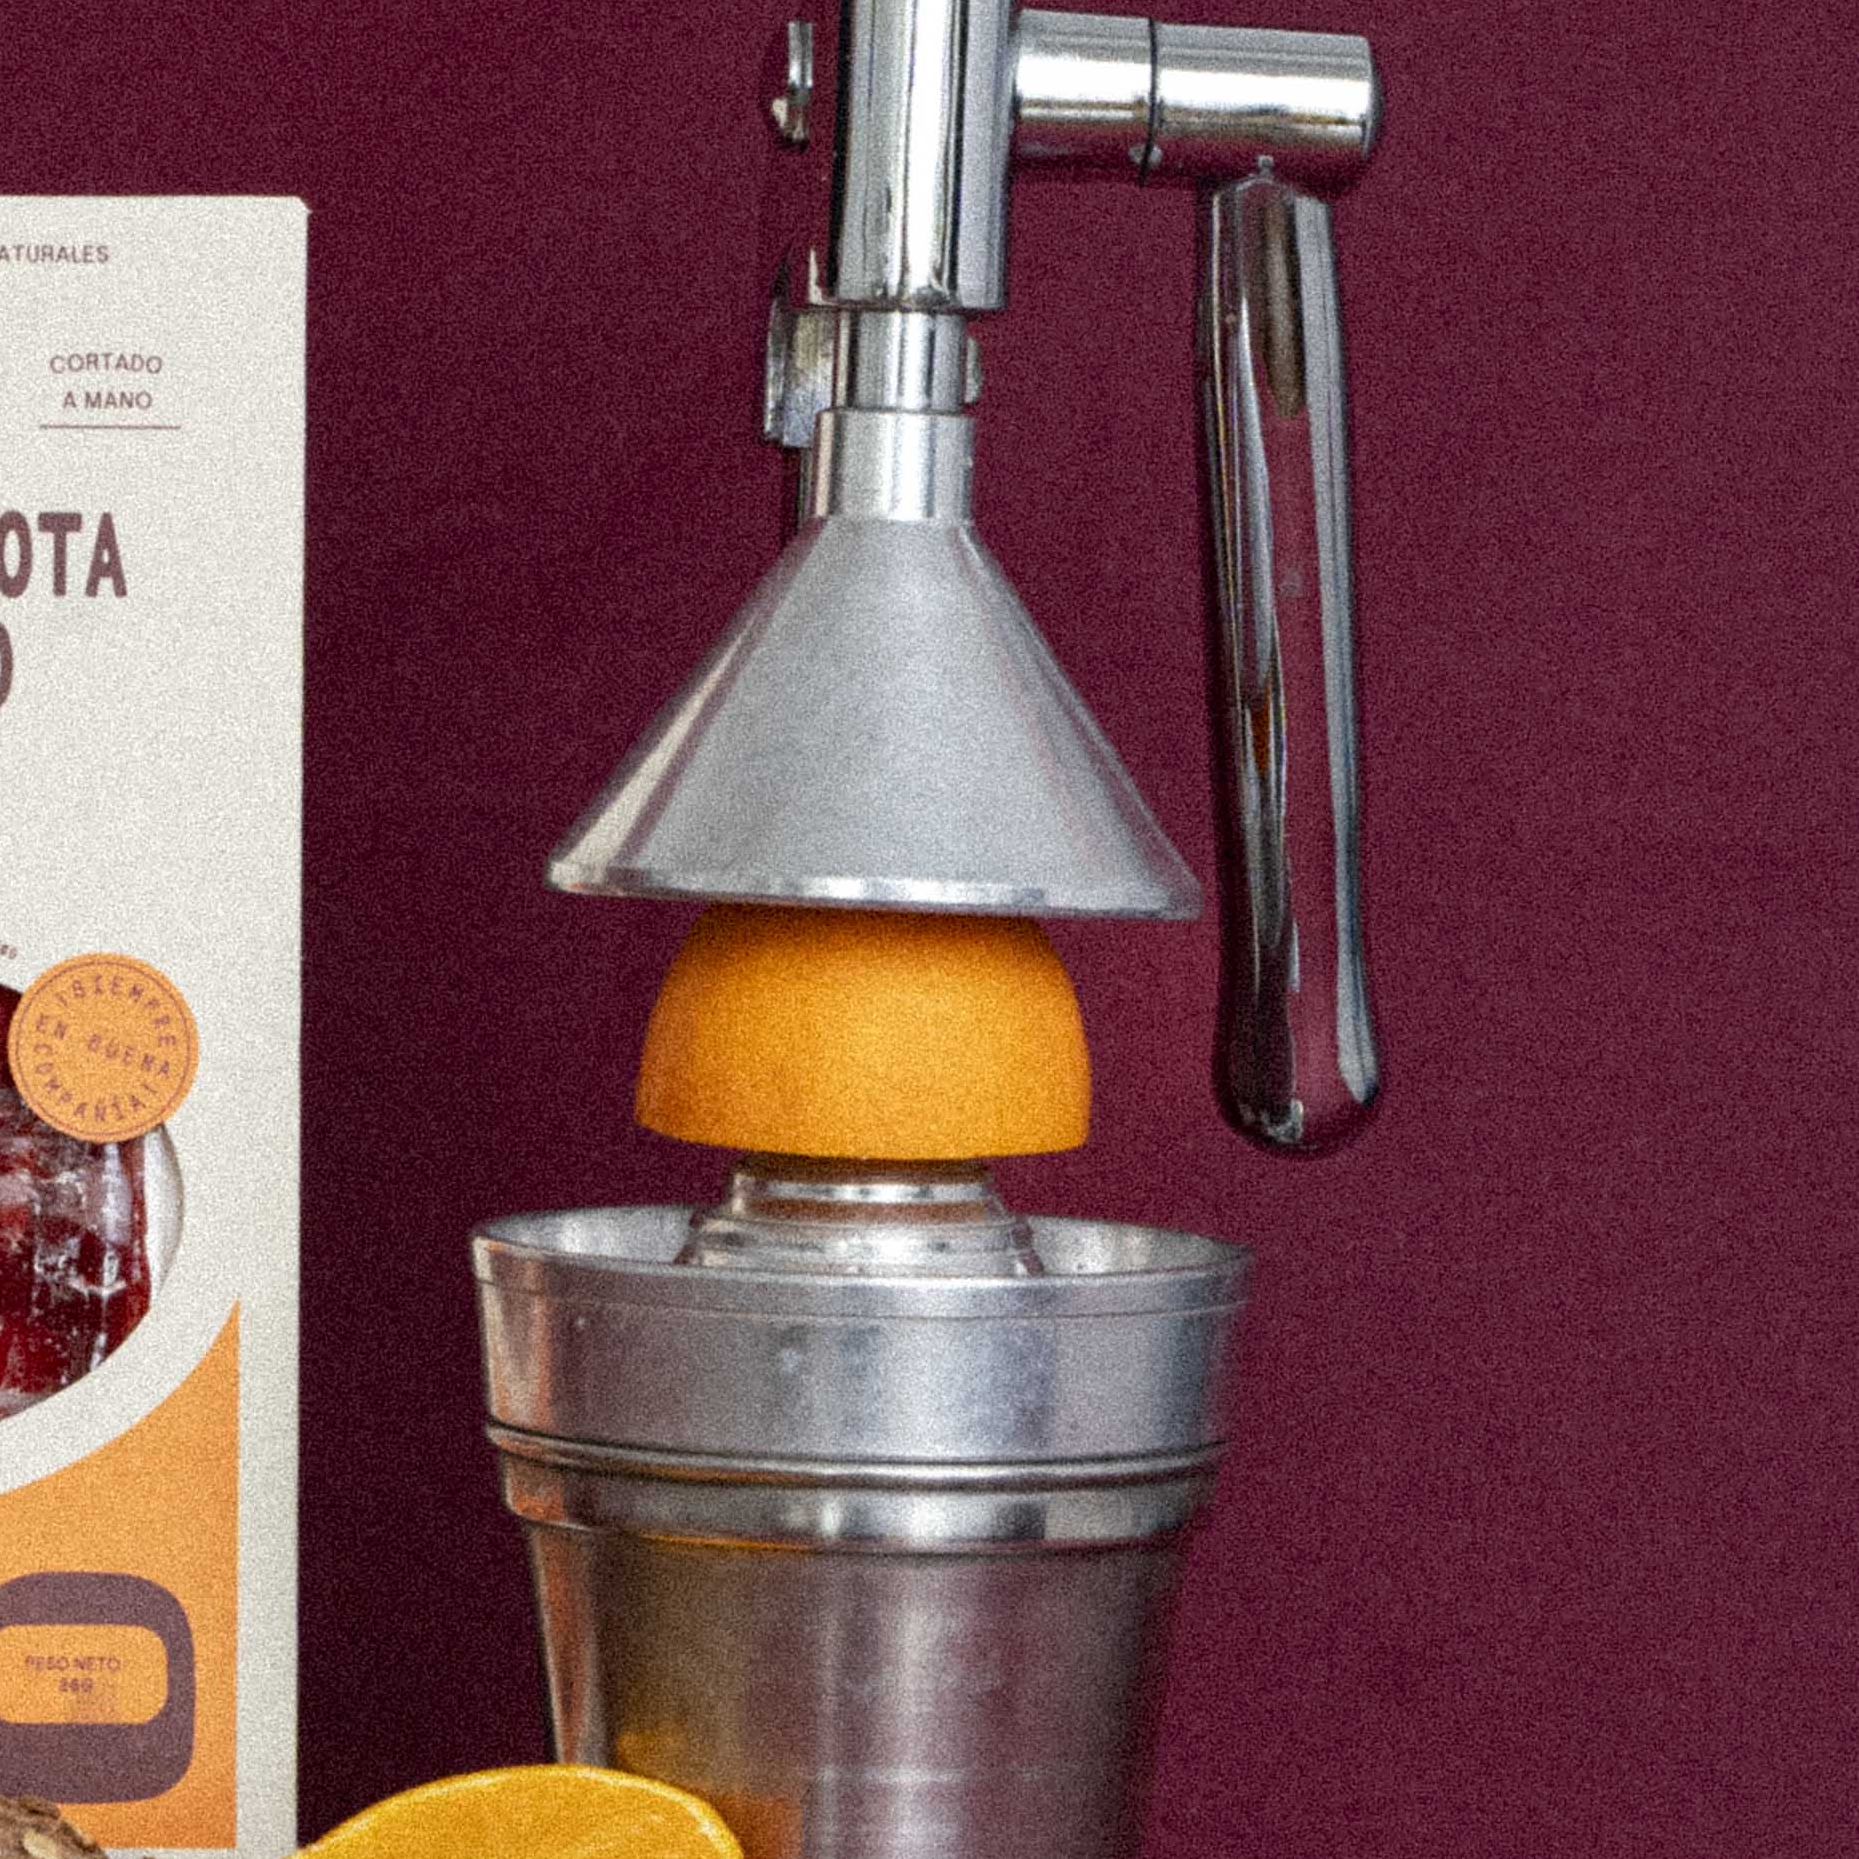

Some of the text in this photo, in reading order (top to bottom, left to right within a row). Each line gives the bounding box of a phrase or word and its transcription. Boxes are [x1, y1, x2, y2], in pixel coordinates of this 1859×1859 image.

[50, 352, 163, 374] CORTADO
[63, 390, 153, 410] A MANO
[35, 1012, 171, 1080] EN BUENA
[25, 1654, 122, 1673] PESO NETO
